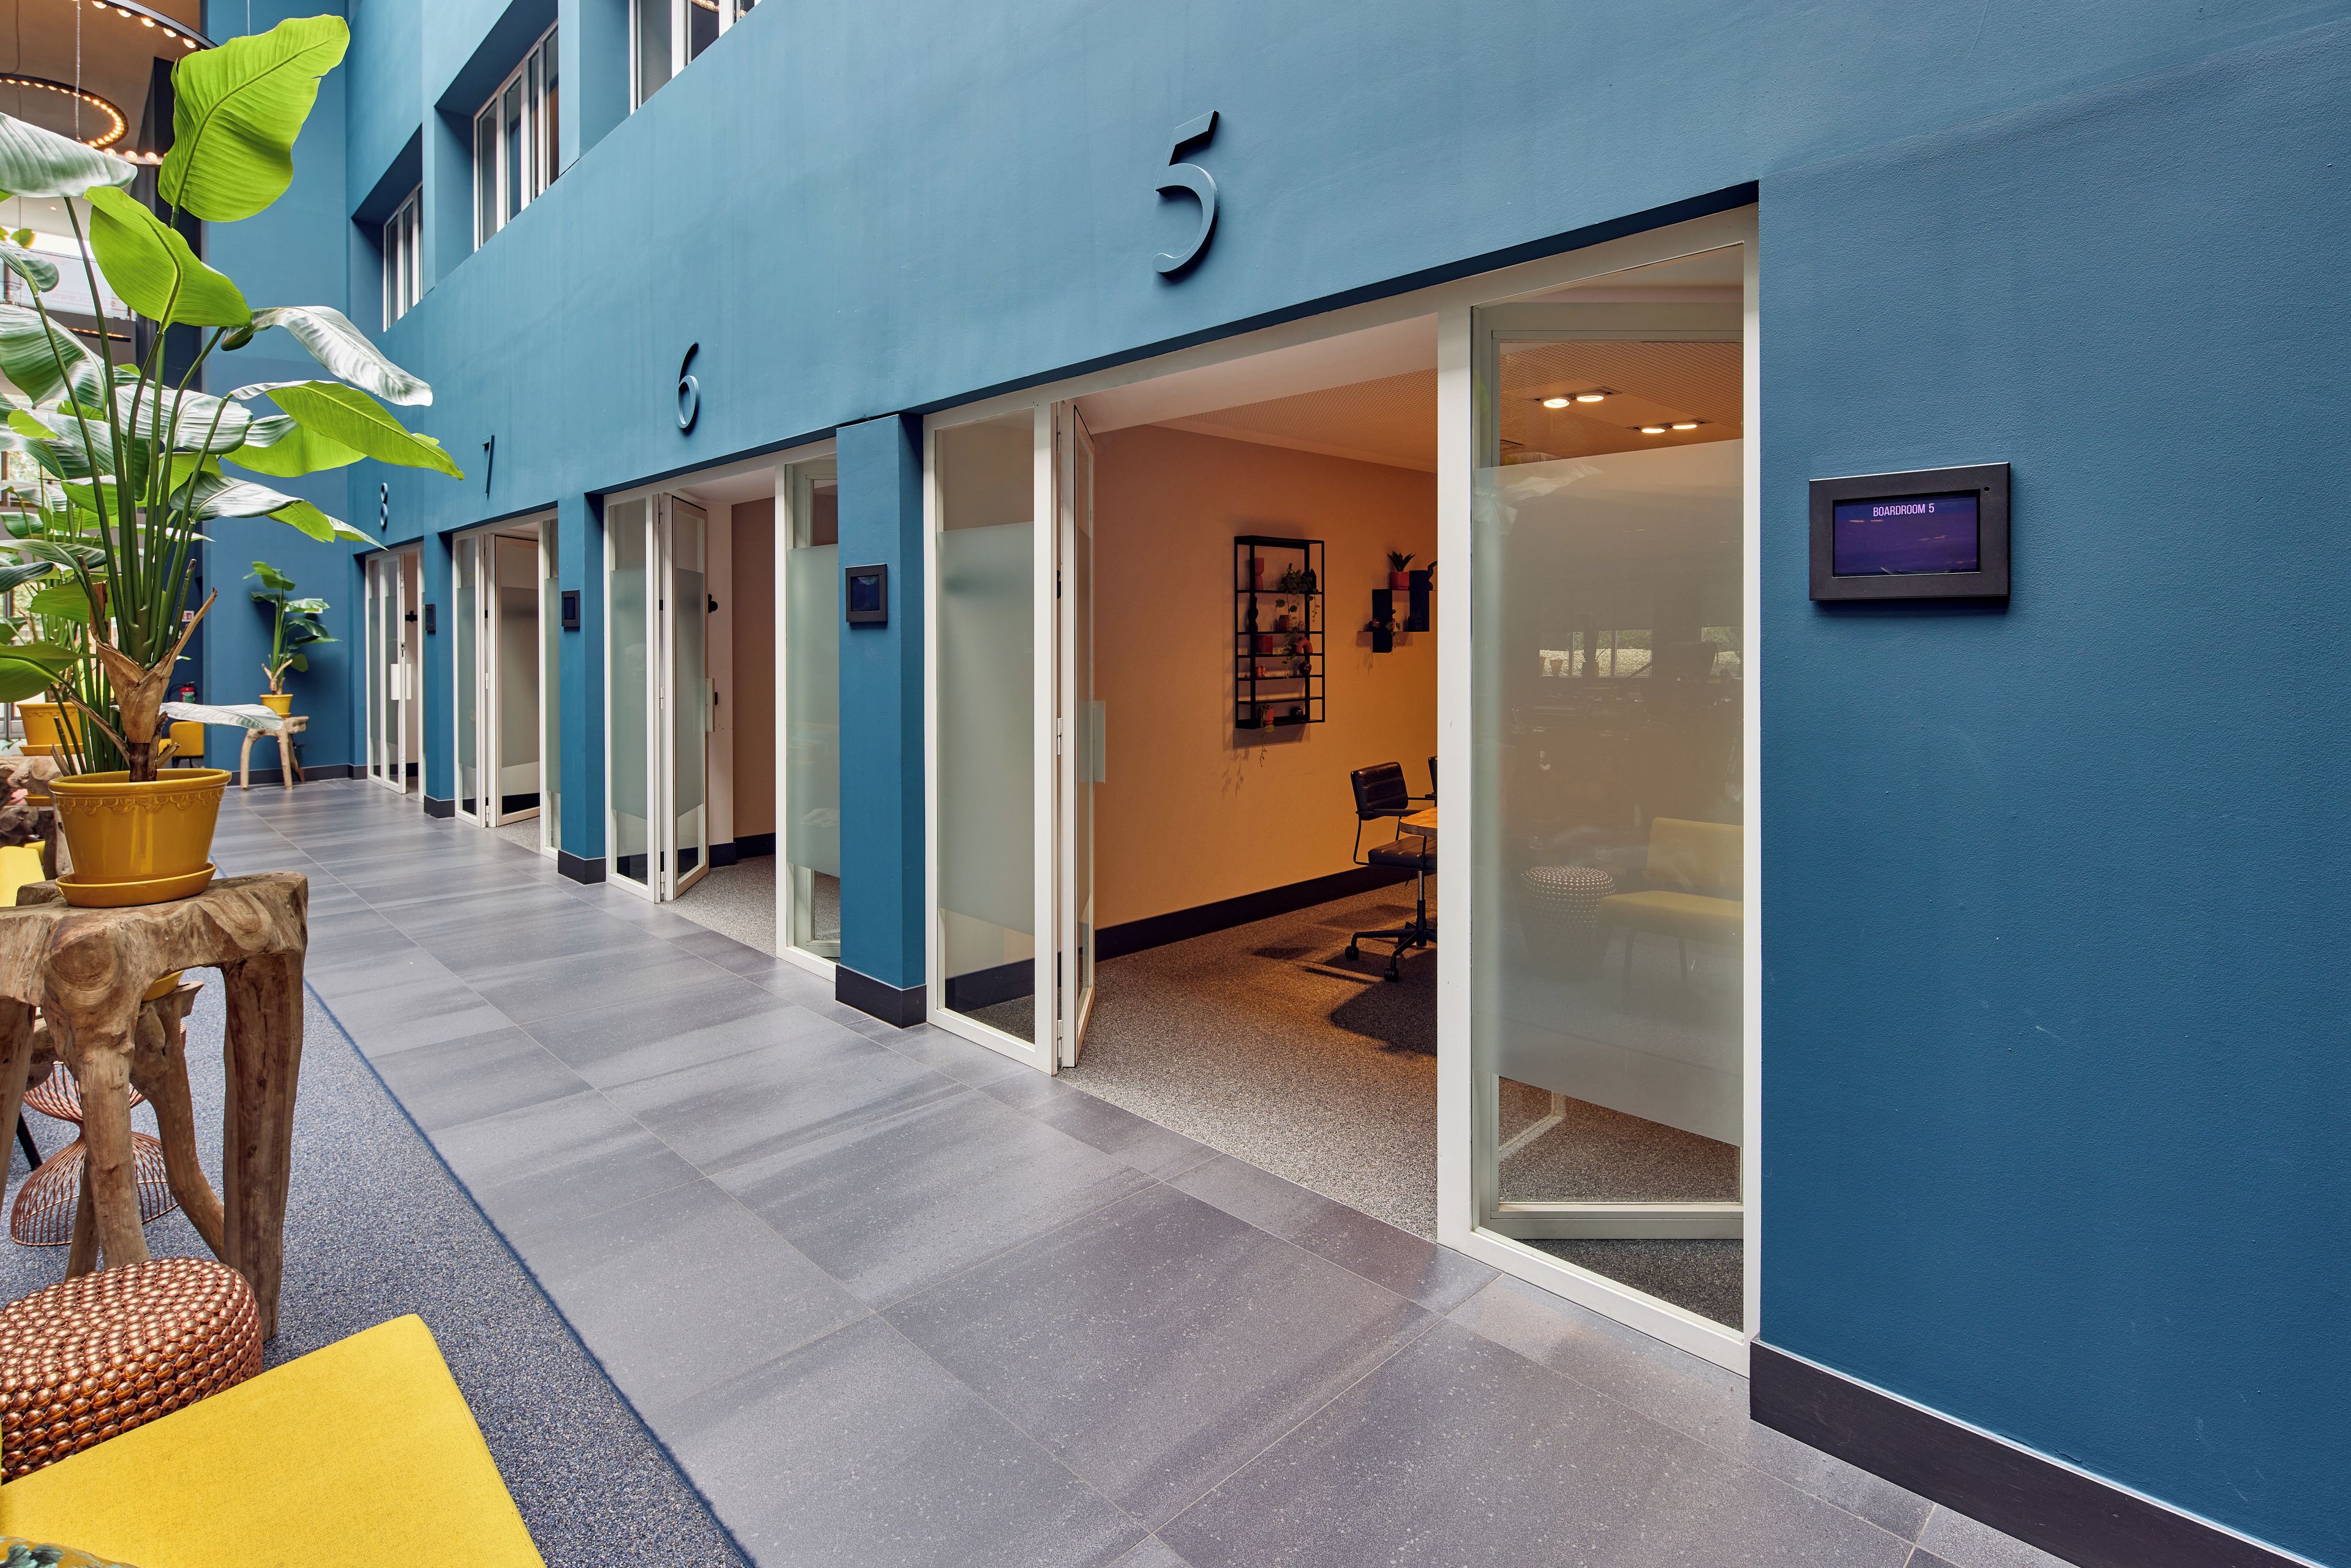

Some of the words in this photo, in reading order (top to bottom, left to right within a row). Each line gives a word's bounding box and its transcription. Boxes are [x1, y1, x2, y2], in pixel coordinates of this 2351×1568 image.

[1152, 110, 1220, 276] 5
[676, 342, 700, 432] 6
[481, 434, 495, 497] 7
[380, 482, 388, 532] 8
[1873, 504, 1925, 517] BOARDROOM
[1929, 503, 1935, 513] 5
